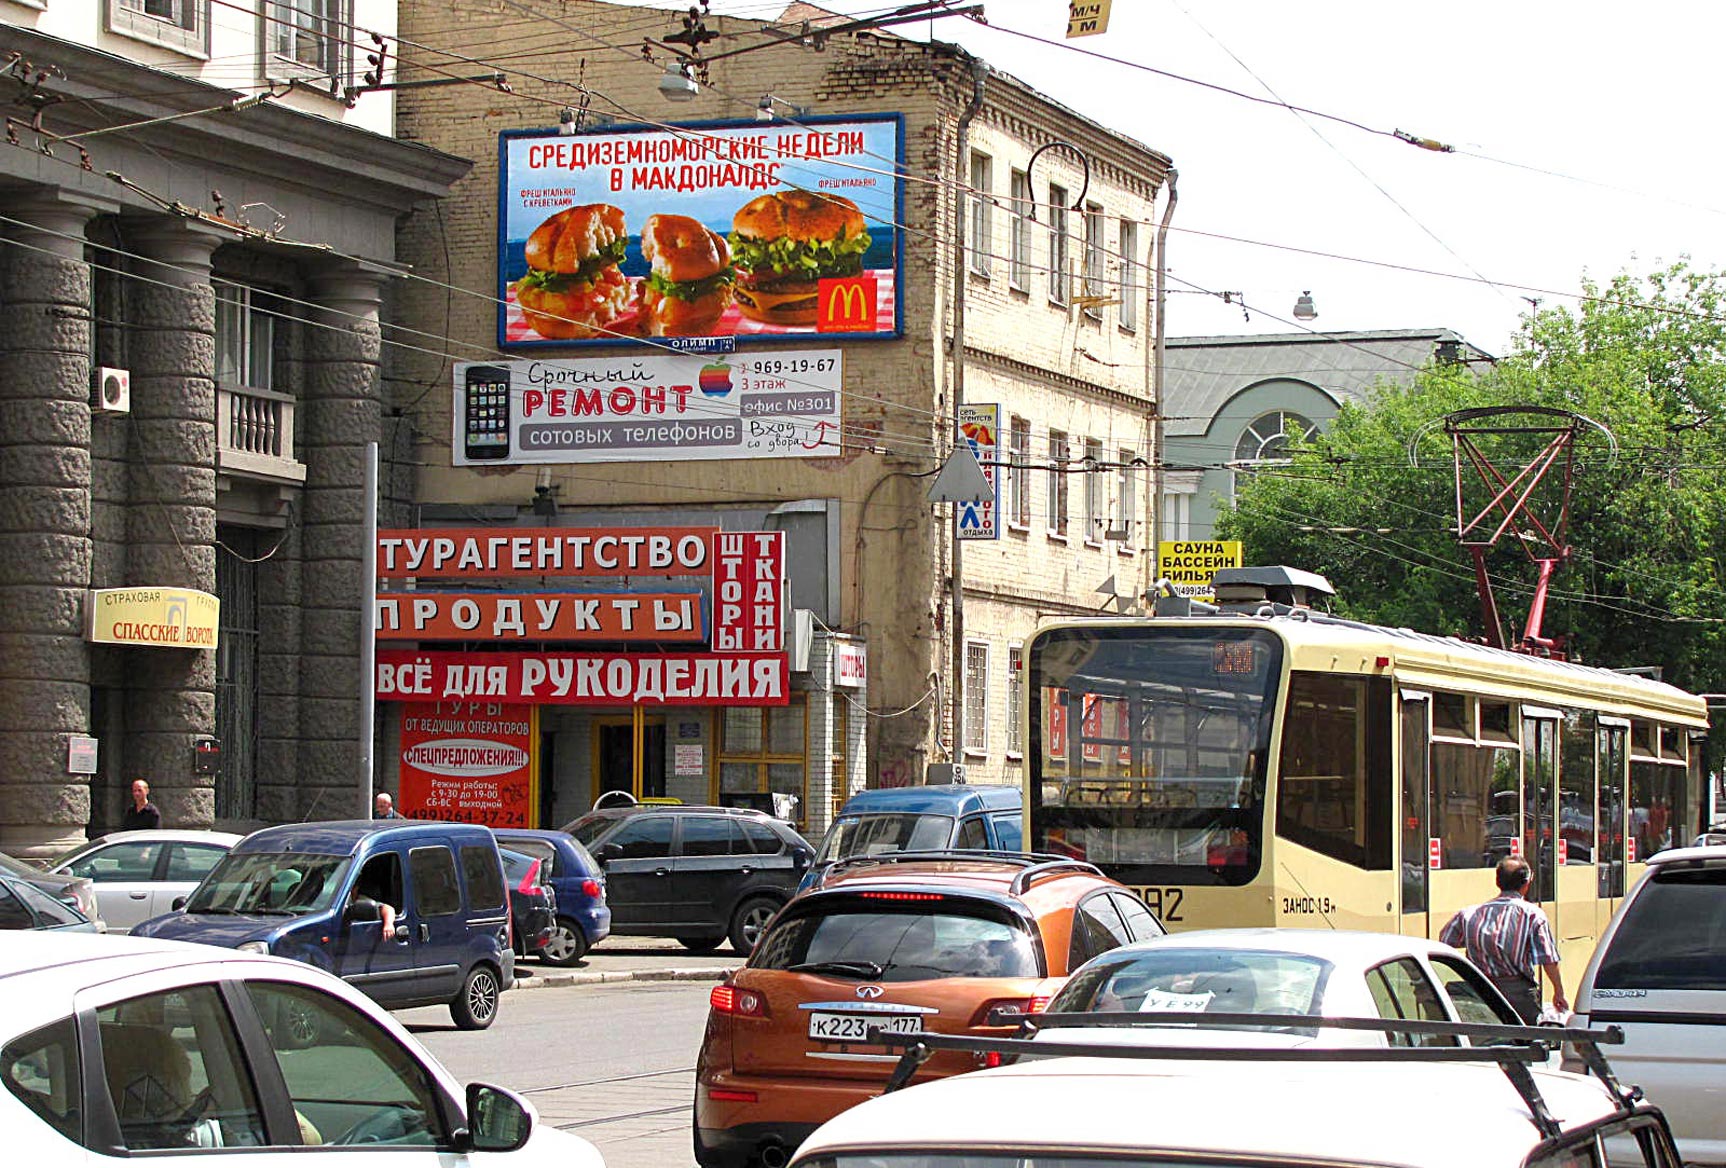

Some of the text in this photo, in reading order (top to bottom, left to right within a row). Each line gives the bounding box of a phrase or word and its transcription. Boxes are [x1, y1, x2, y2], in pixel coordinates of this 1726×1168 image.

[529, 131, 864, 171] СРЕДИЗЕМНОМОРСКИЕ НЕДЕЛИ
[610, 168, 623, 192] В
[528, 358, 835, 394] Срочный 969-19-67
[522, 385, 694, 418] РЕМОНТ
[753, 379, 786, 390] этаж
[744, 397, 833, 415] офис №301
[530, 421, 736, 445] сотовых телефонов
[750, 420, 796, 438] Вход
[378, 534, 707, 571] ТУРАГЕНТСТВО
[1173, 542, 1225, 555] САУНА
[1162, 553, 1235, 568] БАССЕЙН
[1162, 569, 1219, 582] БИЛЬЯ
[105, 591, 161, 606] СТРАХОВАЯ
[719, 534, 744, 650] ШТОРЫ
[753, 534, 776, 650] ТКАНИ
[375, 598, 693, 637] ПРОДУКТЫ
[113, 622, 180, 643] СПАССКИЕ
[840, 653, 865, 679] ШТОРЫ
[377, 657, 782, 702] ВСЁ ДЛЯ РУКОДЕЛИЯ
[405, 718, 530, 736] ОТ ВЕДУЩИХ ОПЕРАТОРОВ
[431, 778, 461, 789] Режим
[438, 789, 458, 799] 9-30
[1131, 888, 1183, 922] 92
[1283, 897, 1315, 914] ЗАНОС
[892, 1017, 916, 1033] 177
